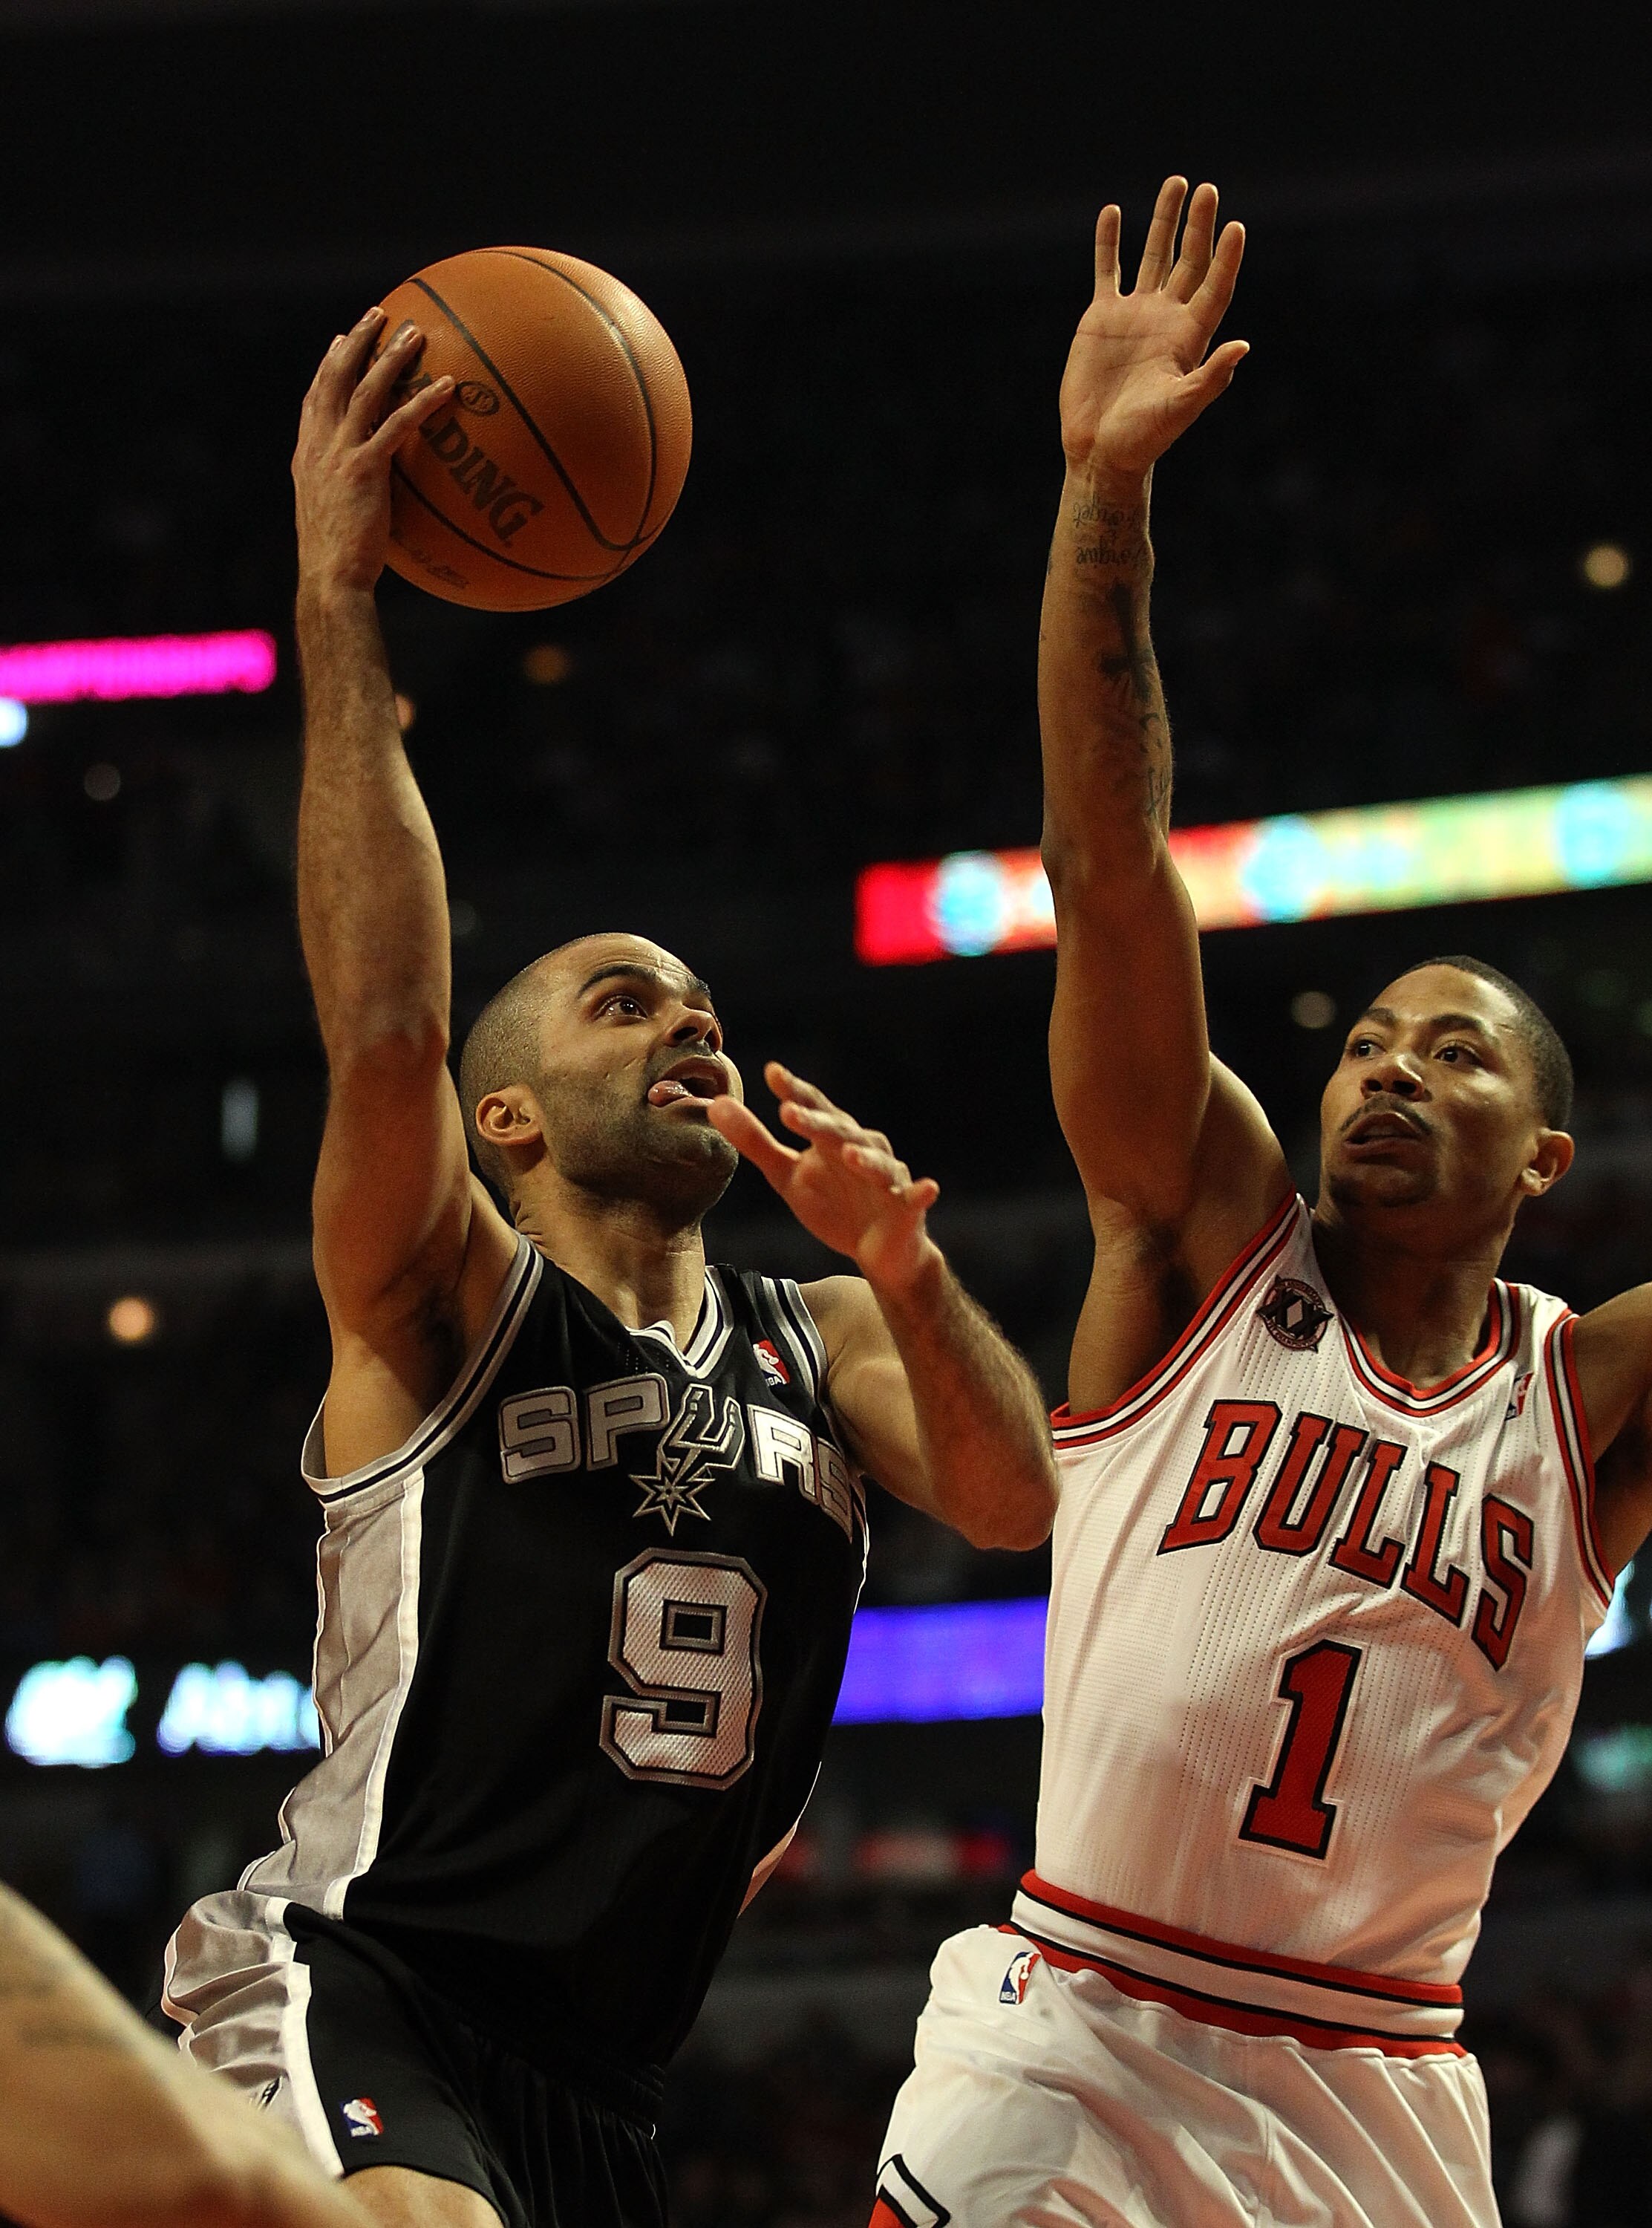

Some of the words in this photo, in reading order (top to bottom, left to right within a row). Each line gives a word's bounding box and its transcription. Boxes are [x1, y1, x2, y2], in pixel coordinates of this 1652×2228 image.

[498, 1372, 853, 1544] SPURS
[1156, 1399, 1535, 1672] BULLS
[599, 1546, 768, 1791] 9
[1238, 1638, 1363, 1860] 1
